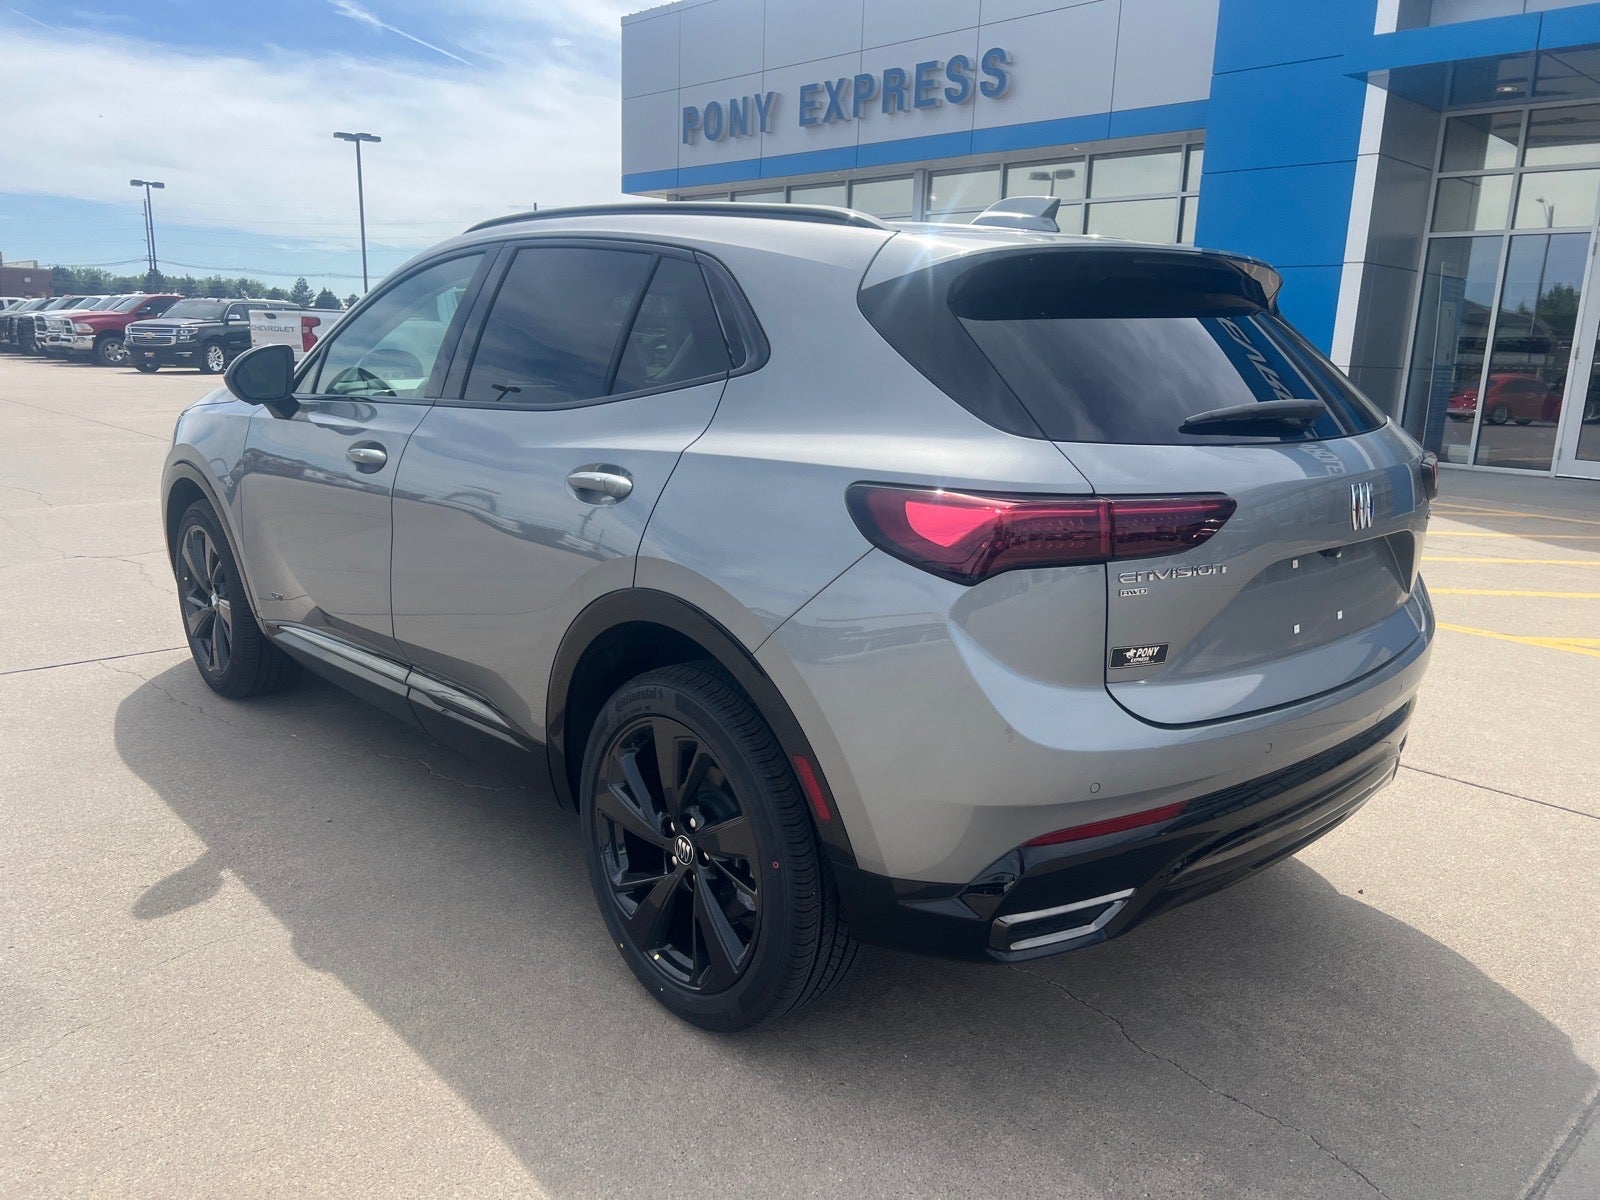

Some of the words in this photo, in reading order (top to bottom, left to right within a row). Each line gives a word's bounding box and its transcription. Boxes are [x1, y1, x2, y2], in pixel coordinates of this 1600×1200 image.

[682, 91, 780, 145] PONY
[799, 47, 1013, 127] EXPRESS
[251, 324, 295, 333] CHEVROLET
[1119, 563, 1227, 584] ENVISION
[1120, 588, 1148, 597] AWD
[1135, 646, 1160, 658] PONY
